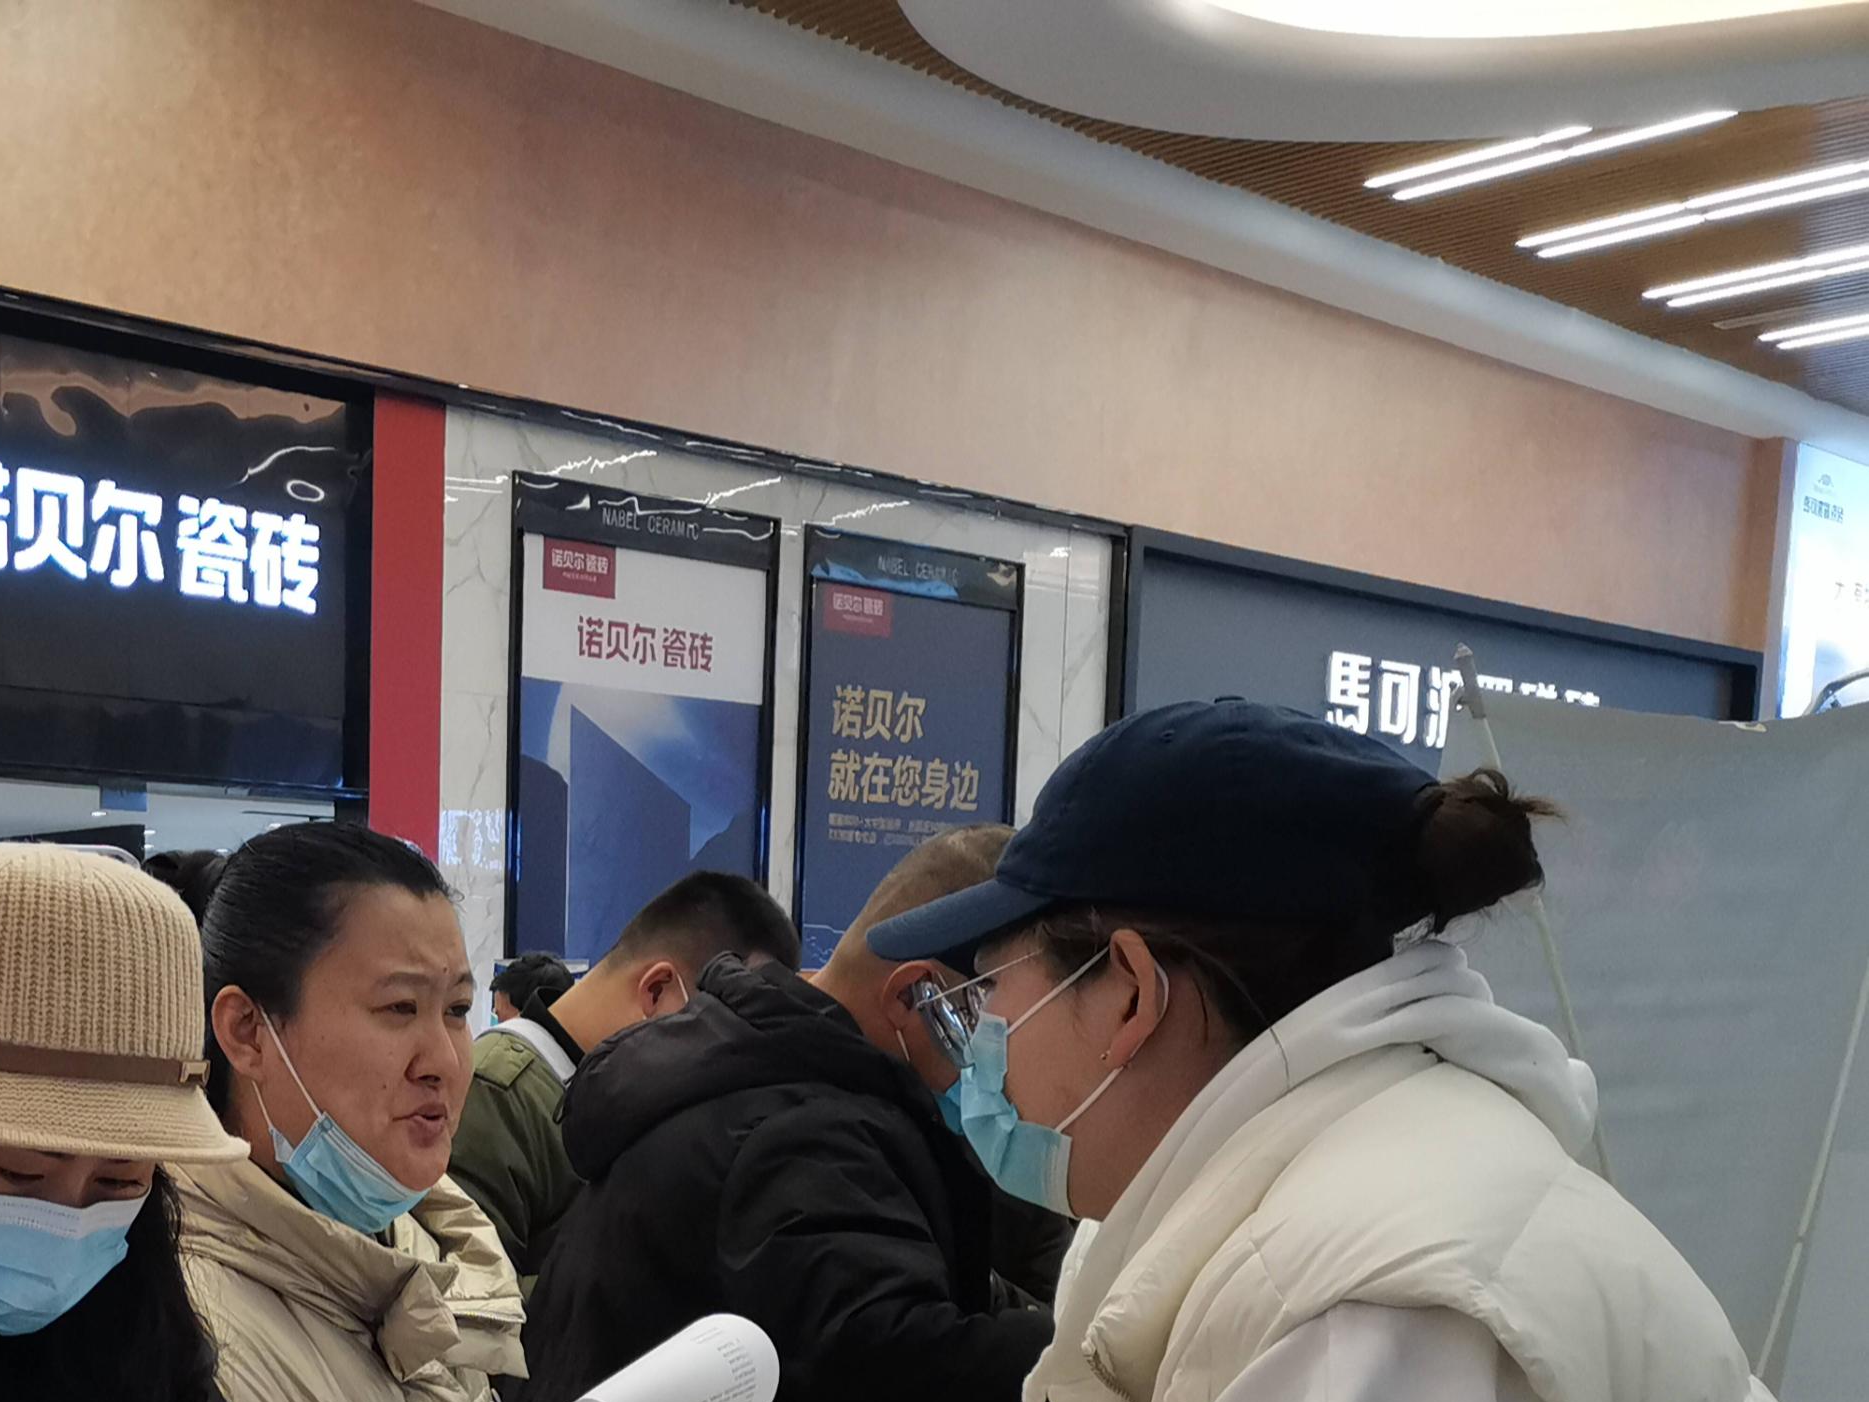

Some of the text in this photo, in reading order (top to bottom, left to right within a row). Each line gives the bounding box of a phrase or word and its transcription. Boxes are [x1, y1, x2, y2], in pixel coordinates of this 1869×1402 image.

[602, 507, 700, 541] NABEL CERAMIC
[831, 684, 928, 744] 诺贝尔
[827, 749, 980, 812] 就在您身边
